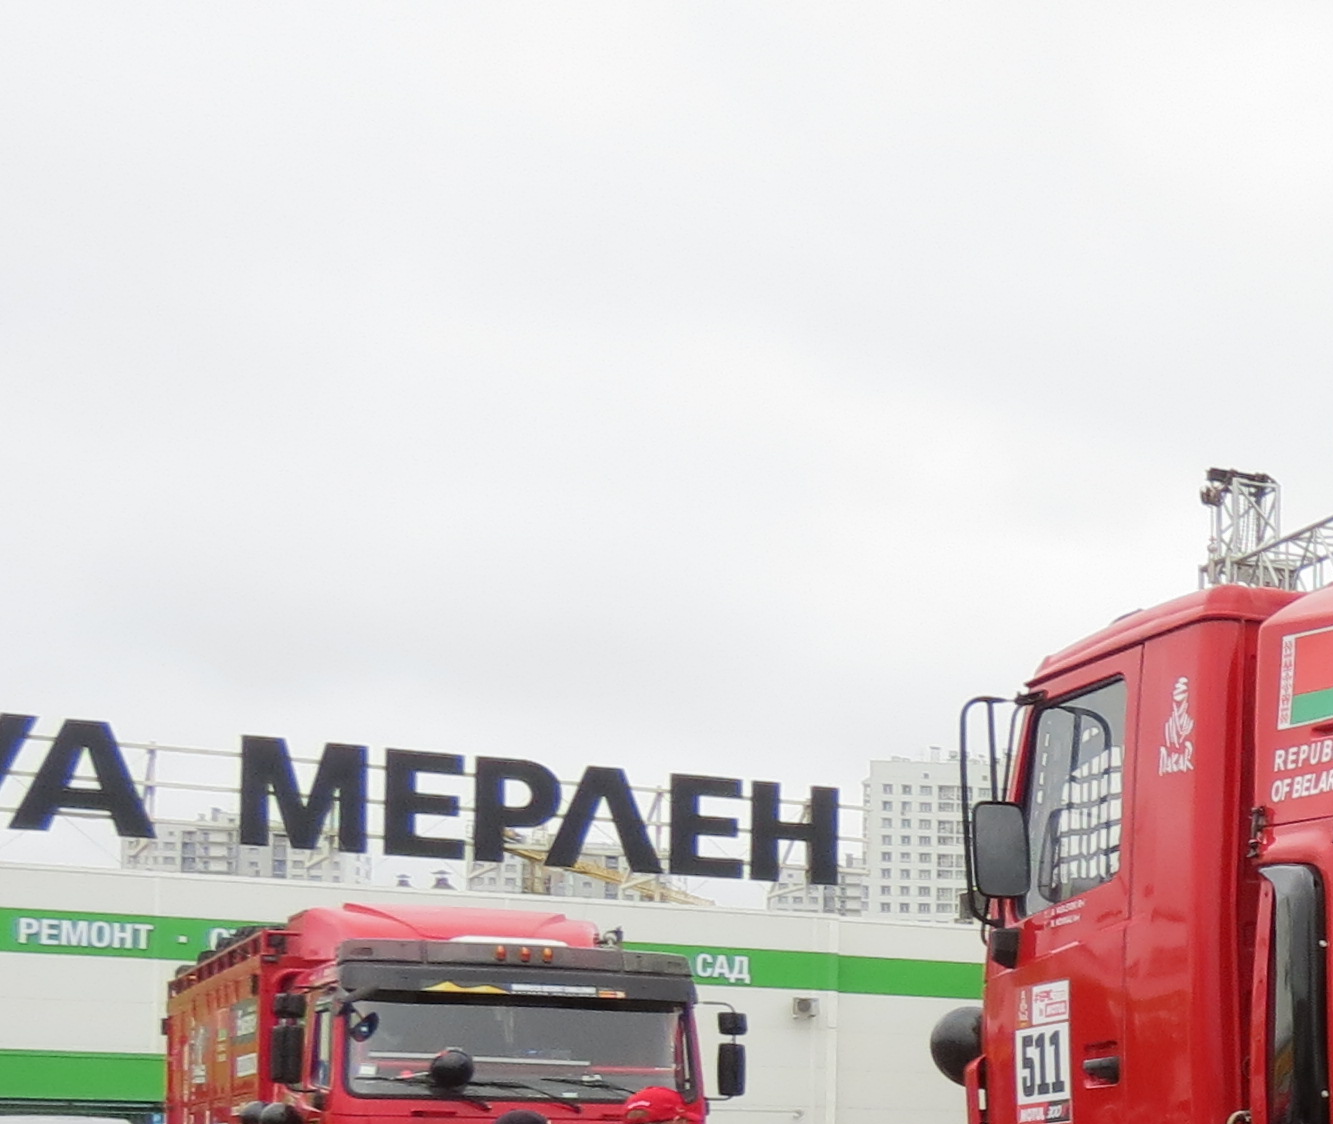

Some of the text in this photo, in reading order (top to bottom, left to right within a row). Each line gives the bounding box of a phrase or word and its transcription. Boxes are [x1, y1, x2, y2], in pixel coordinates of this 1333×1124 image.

[1271, 778, 1292, 803] OF
[240, 734, 840, 886] МЕРЛЕН
[17, 917, 154, 950] РЕМОНТ
[696, 953, 751, 984] САД
[1021, 1030, 1065, 1097] 511
